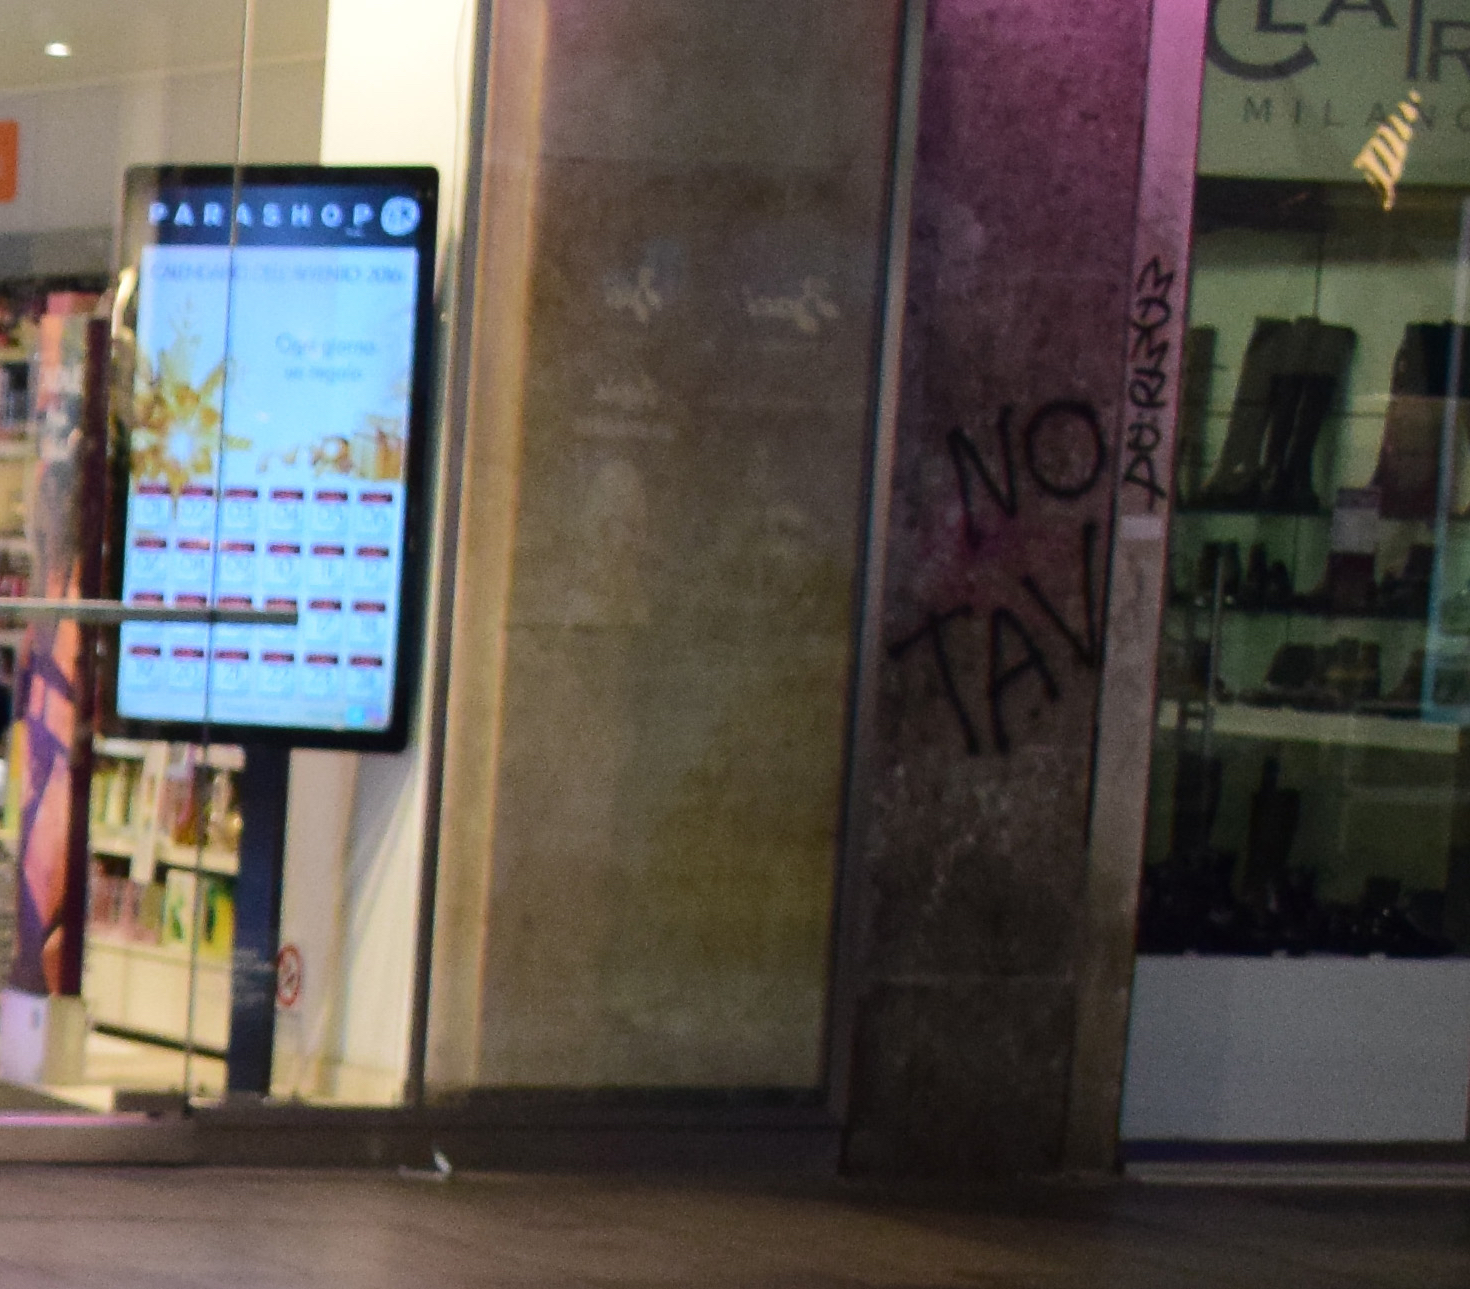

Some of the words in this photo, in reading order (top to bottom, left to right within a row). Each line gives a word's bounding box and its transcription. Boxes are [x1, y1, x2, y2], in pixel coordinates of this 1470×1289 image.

[147, 202, 375, 228] PARASHOP
[947, 401, 1107, 550] NO
[889, 522, 1102, 756] TAV
